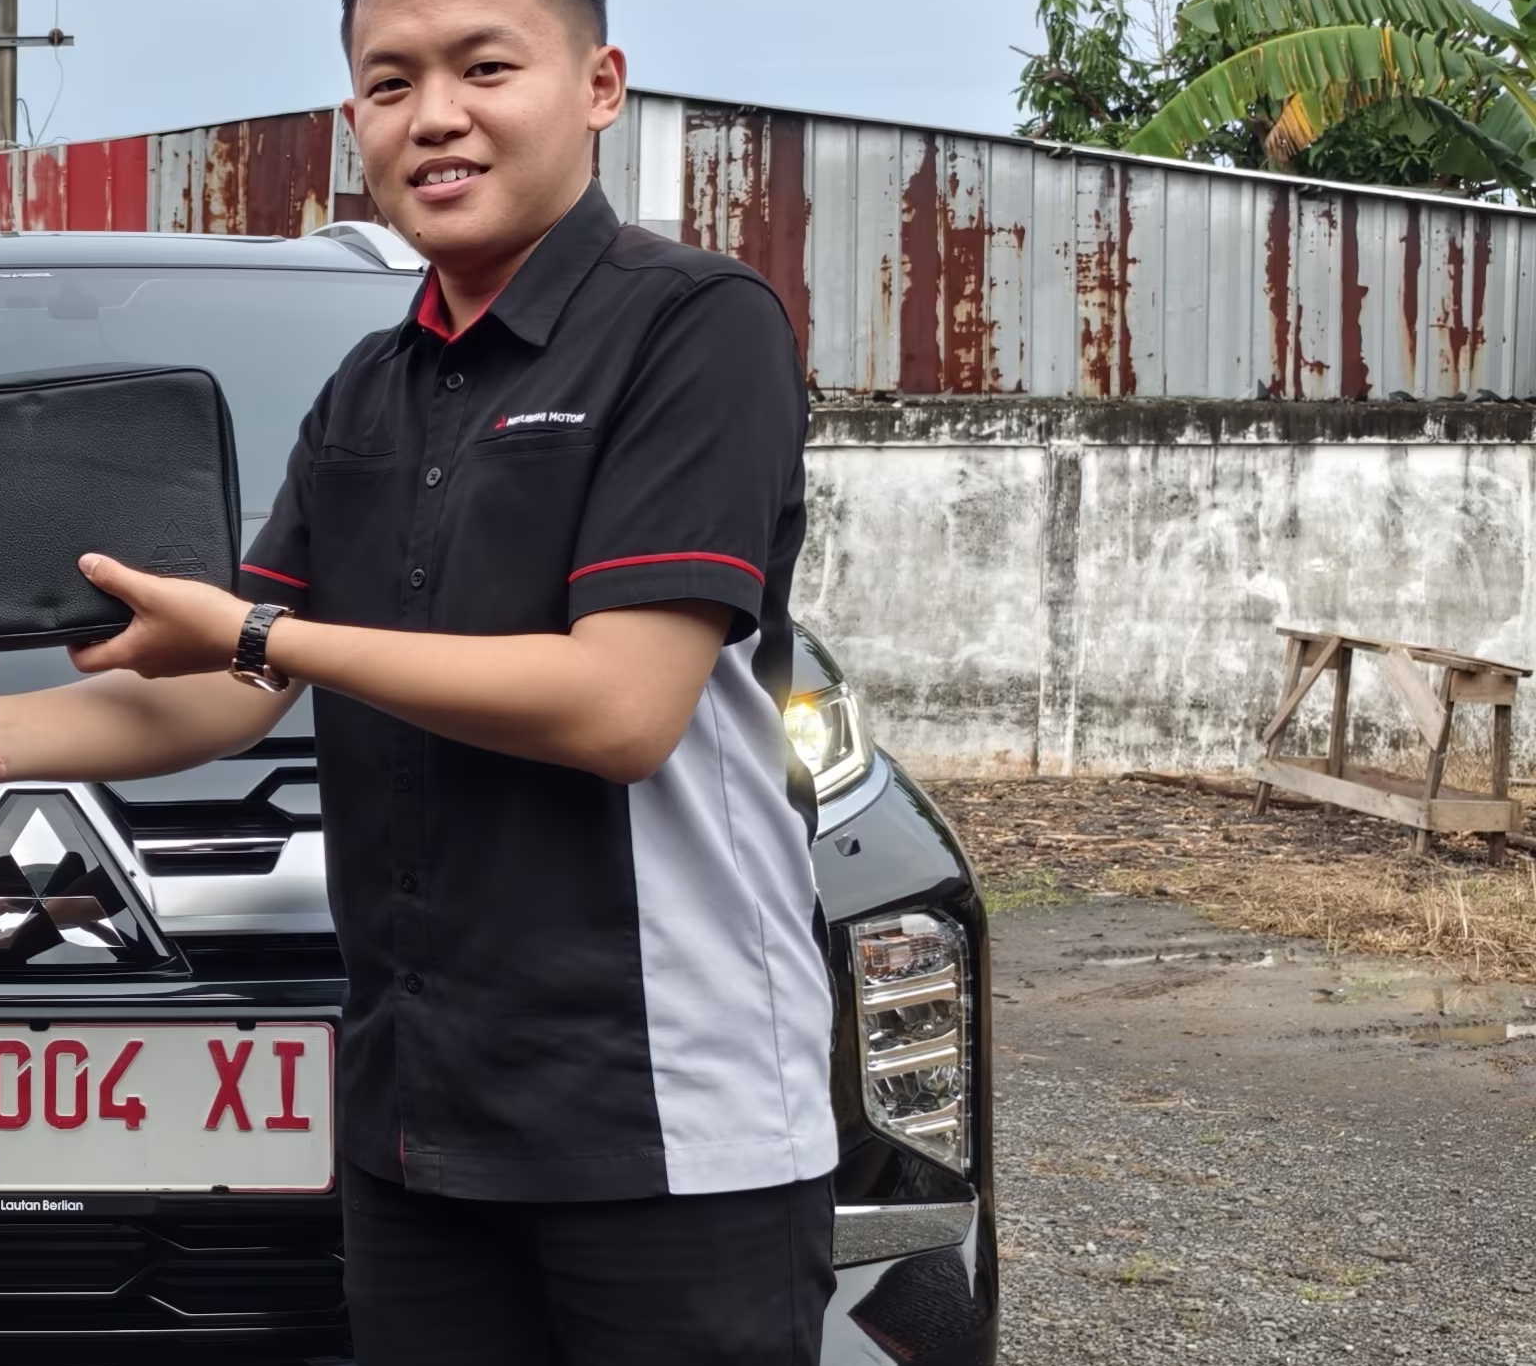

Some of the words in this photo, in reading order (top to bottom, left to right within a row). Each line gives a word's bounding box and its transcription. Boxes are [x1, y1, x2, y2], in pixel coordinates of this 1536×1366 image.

[203, 1039, 311, 1131] XI
[0, 1199, 41, 1211] Lautan
[42, 1199, 84, 1211] Berlian
